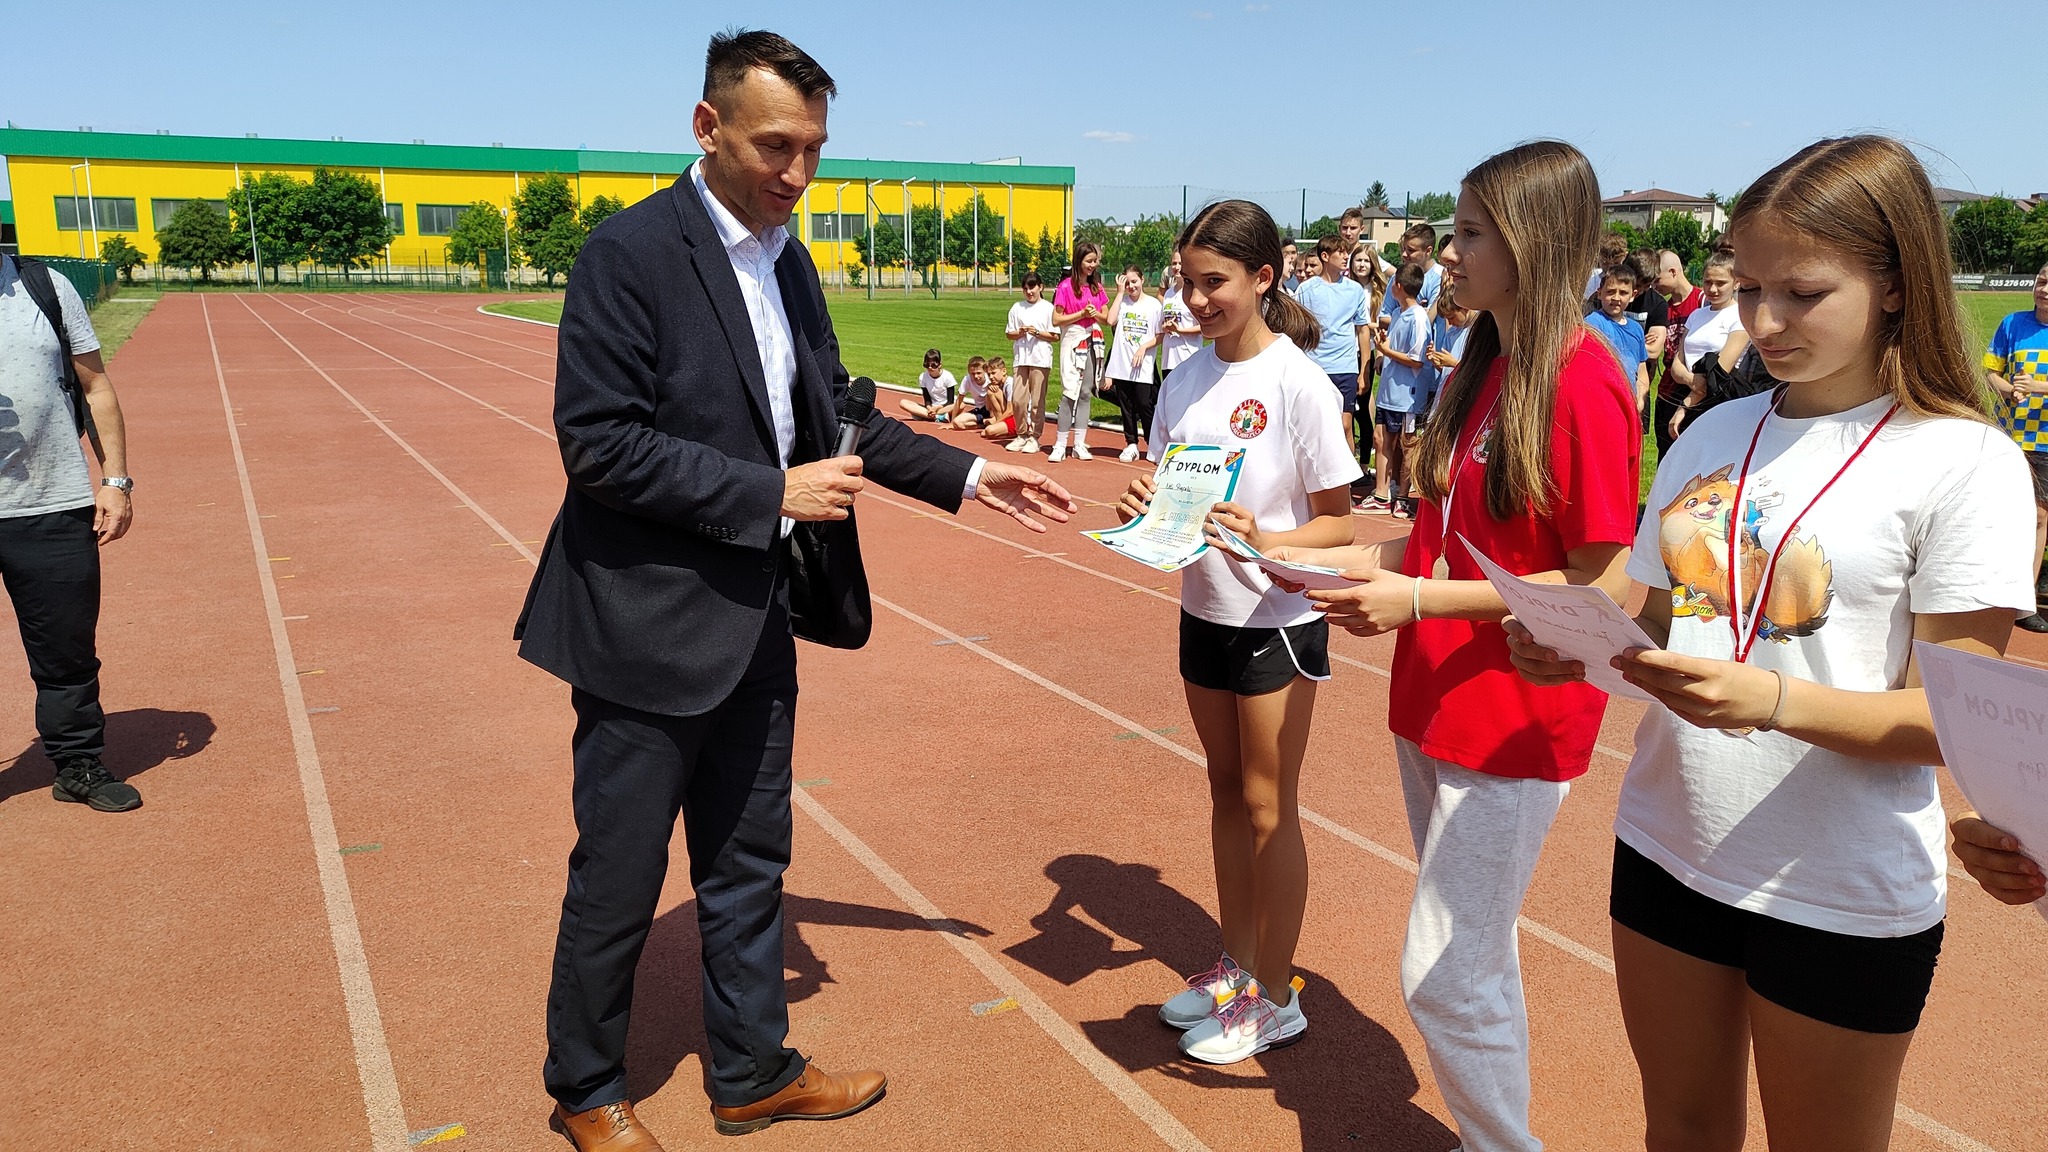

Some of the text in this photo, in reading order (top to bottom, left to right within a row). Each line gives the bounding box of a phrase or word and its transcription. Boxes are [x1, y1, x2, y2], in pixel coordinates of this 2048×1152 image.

[2003, 279, 2018, 287] 276
[2019, 279, 2034, 287] 079
[1176, 462, 1221, 475] DYPLOM
